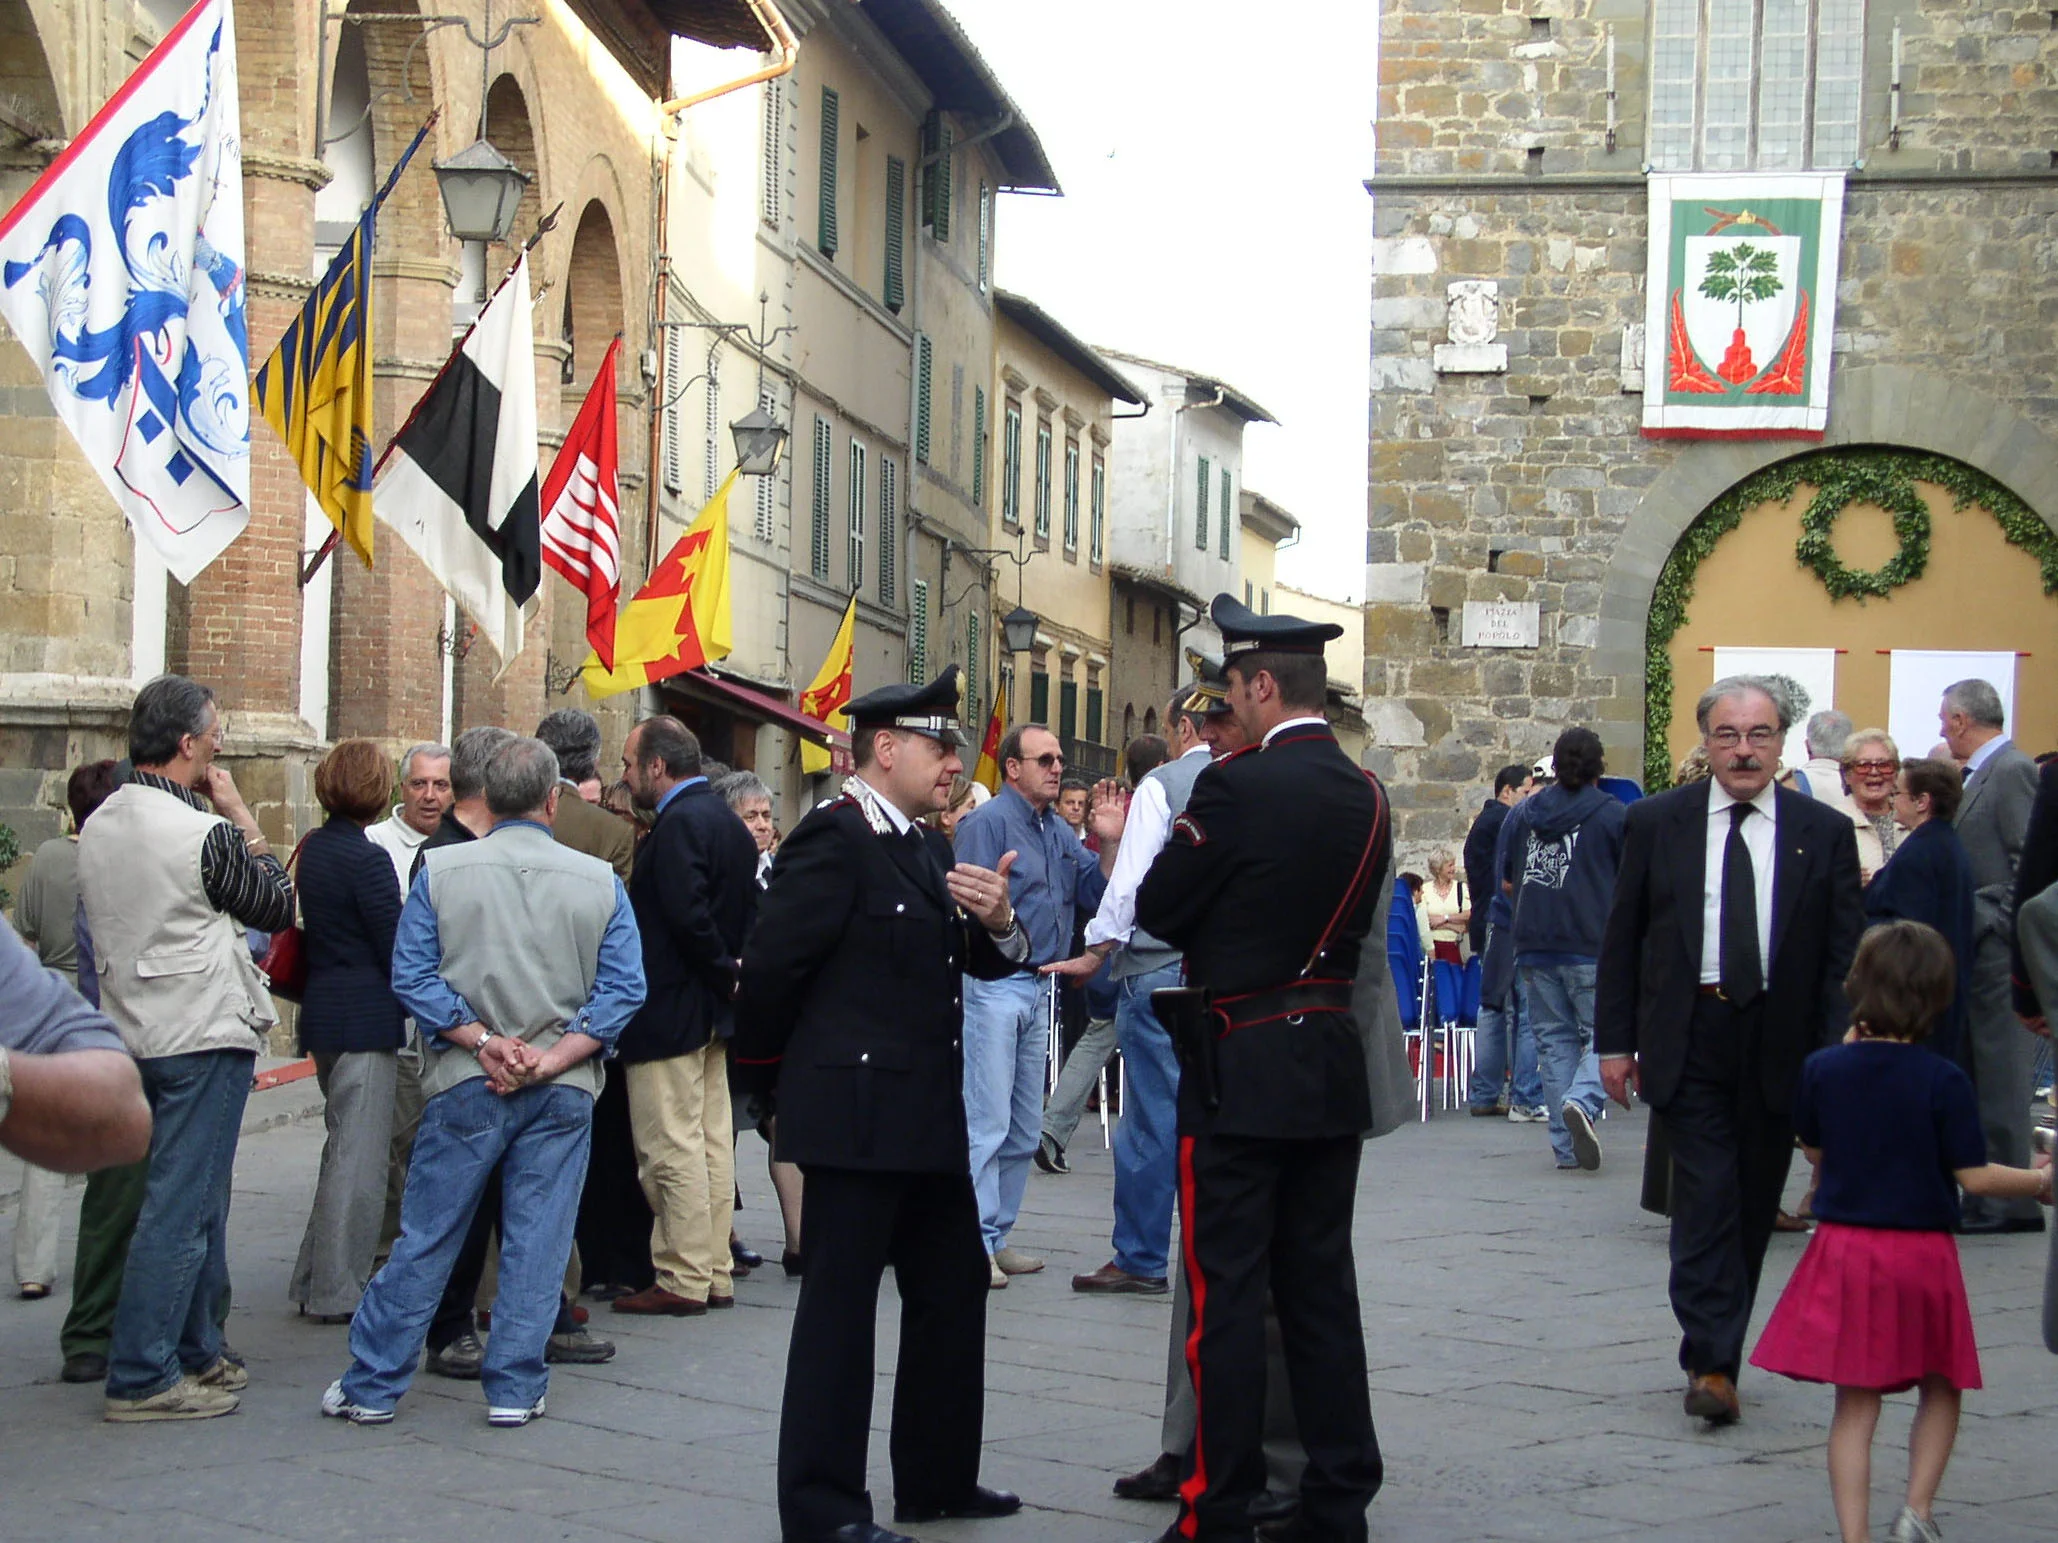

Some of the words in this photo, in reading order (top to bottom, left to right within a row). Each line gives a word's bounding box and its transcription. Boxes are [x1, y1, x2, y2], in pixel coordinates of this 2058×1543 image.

[1485, 607, 1518, 616] PIAZZA
[1490, 619, 1508, 628] DEL
[1478, 631, 1521, 640] POPOLO
